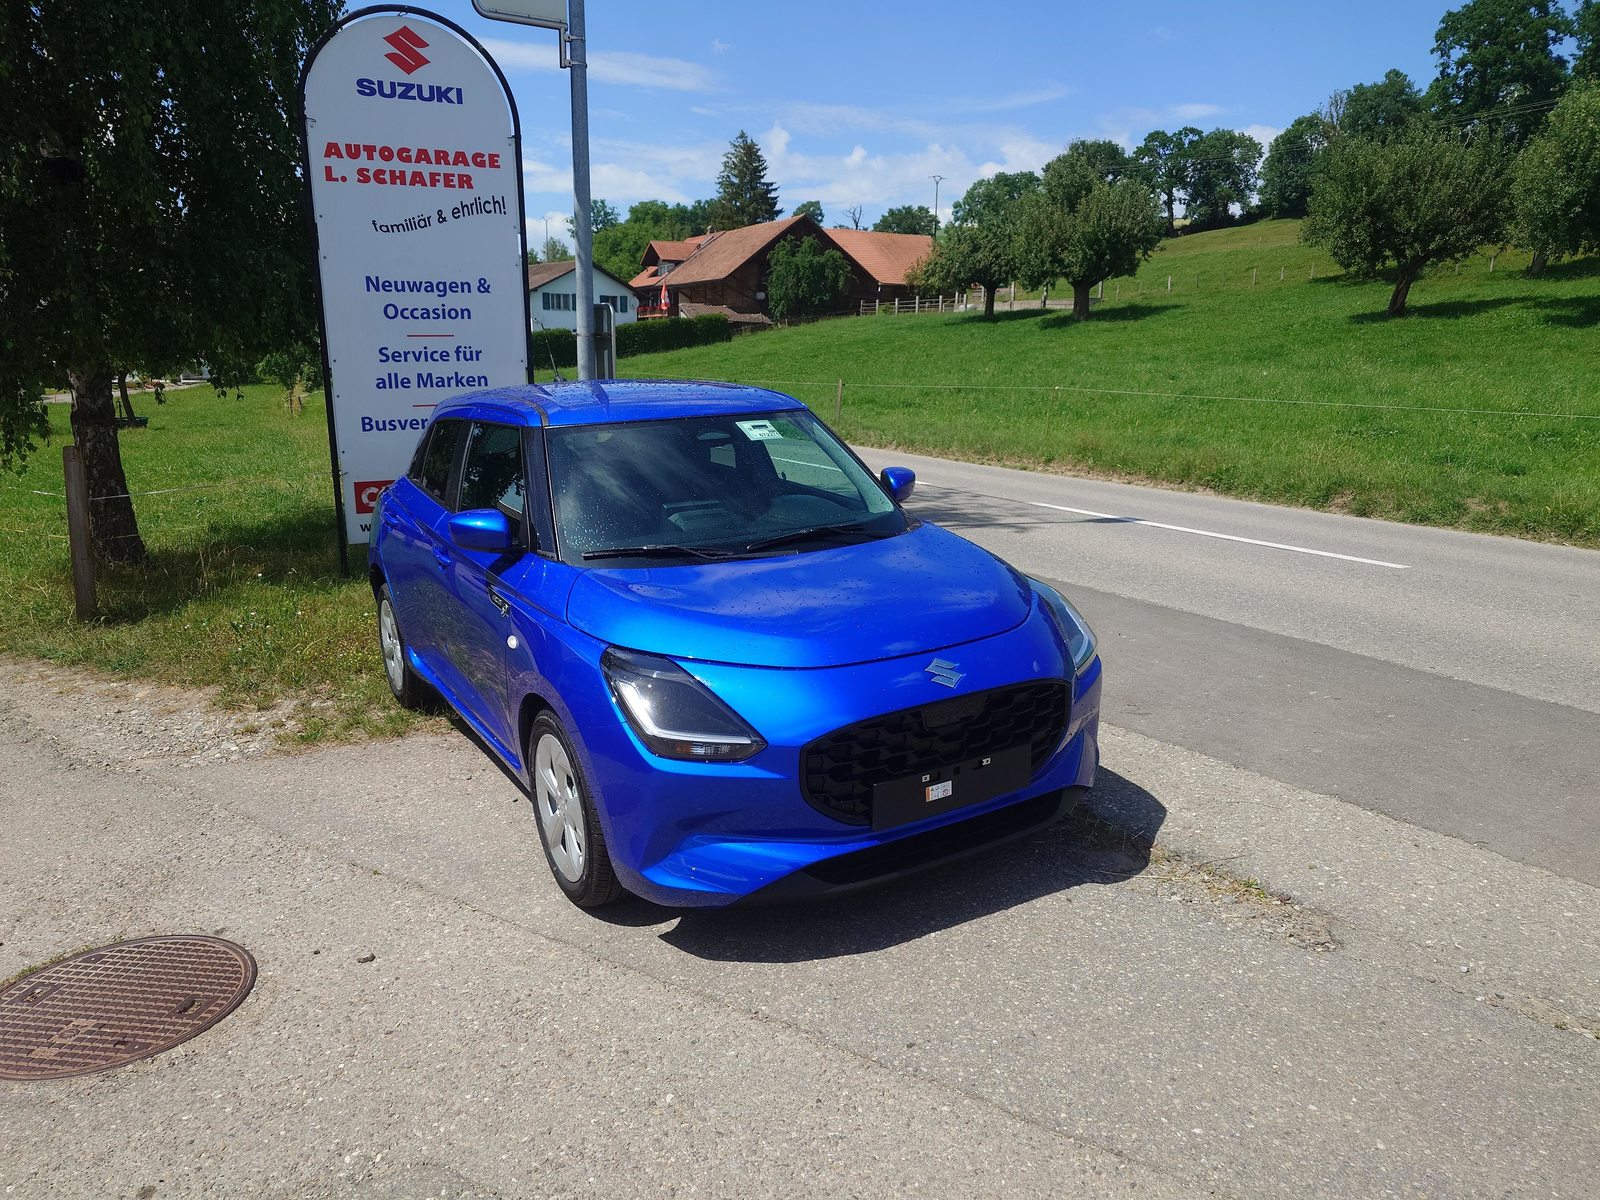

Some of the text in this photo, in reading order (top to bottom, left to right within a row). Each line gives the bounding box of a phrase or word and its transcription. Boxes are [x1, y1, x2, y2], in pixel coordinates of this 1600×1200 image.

[356, 78, 464, 105] SUZUKI
[324, 142, 501, 169] AUTOGARAGE
[324, 166, 474, 190] L. SCHAFER
[372, 195, 507, 234] familiär & ehrlich!
[365, 275, 491, 298] Neuwagen &
[383, 303, 472, 320] Occasion
[378, 345, 483, 364] Service für
[375, 371, 489, 390] alle Marken
[361, 416, 429, 433] Busver
